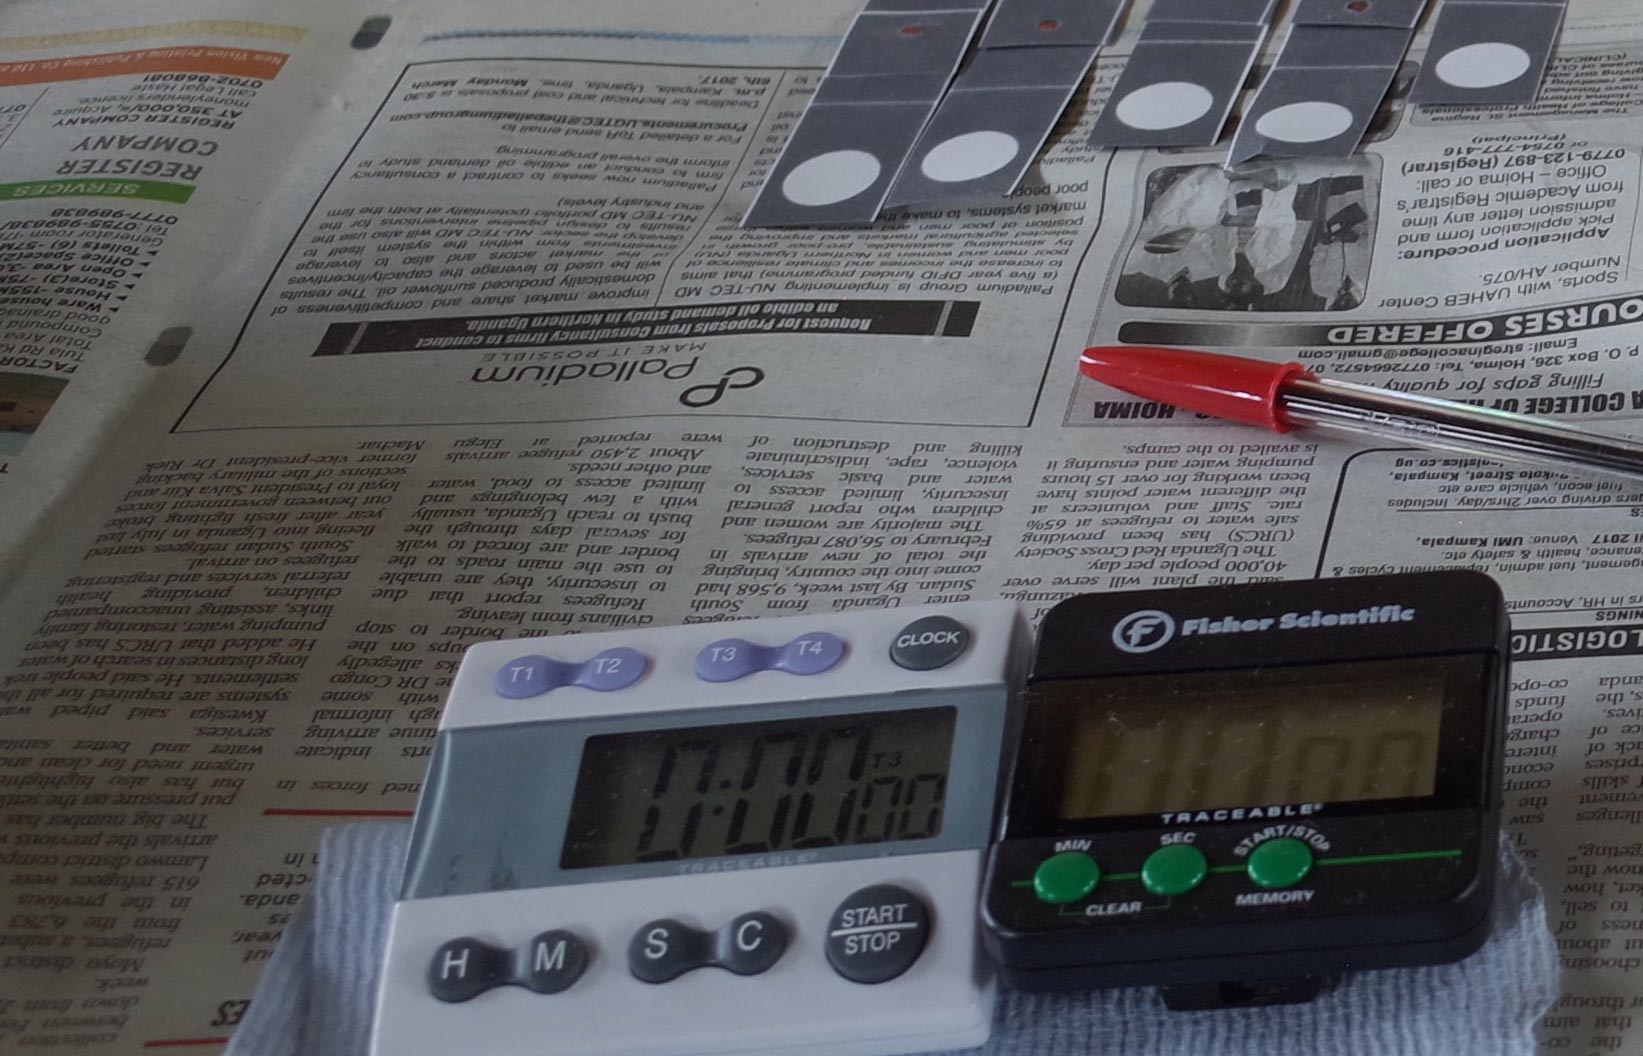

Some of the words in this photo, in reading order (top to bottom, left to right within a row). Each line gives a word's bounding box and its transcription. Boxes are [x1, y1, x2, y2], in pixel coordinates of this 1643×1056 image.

[72, 135, 219, 156] COMPANY
[56, 159, 204, 181] REGISTER
[13, 183, 140, 197] SERVICES
[1516, 279, 1551, 294] with
[1557, 270, 1619, 288] Sports,
[1378, 294, 1439, 312] Center
[1444, 285, 1511, 306] UAHEB
[1326, 320, 1494, 345] OFFERED
[470, 356, 699, 387] Palladium
[1524, 391, 1625, 415] COLLEGE
[1181, 615, 1275, 636] Fisher
[1279, 604, 1415, 630] Scientific
[897, 629, 962, 648] CLOCK
[710, 647, 736, 663] T3
[798, 640, 823, 655] T4
[510, 667, 535, 683] T1
[594, 658, 621, 674] T2
[873, 752, 902, 768] T3
[1055, 840, 1091, 851] MIN
[1160, 831, 1196, 845] SEC
[1233, 825, 1331, 858] START/STOP
[1235, 890, 1314, 907] MEMORY
[841, 903, 908, 926] START
[1086, 902, 1142, 917] CLEAR
[645, 928, 669, 959] S
[736, 920, 764, 951] C
[844, 931, 900, 955] STOP
[441, 949, 470, 979] H
[533, 941, 568, 972] M
